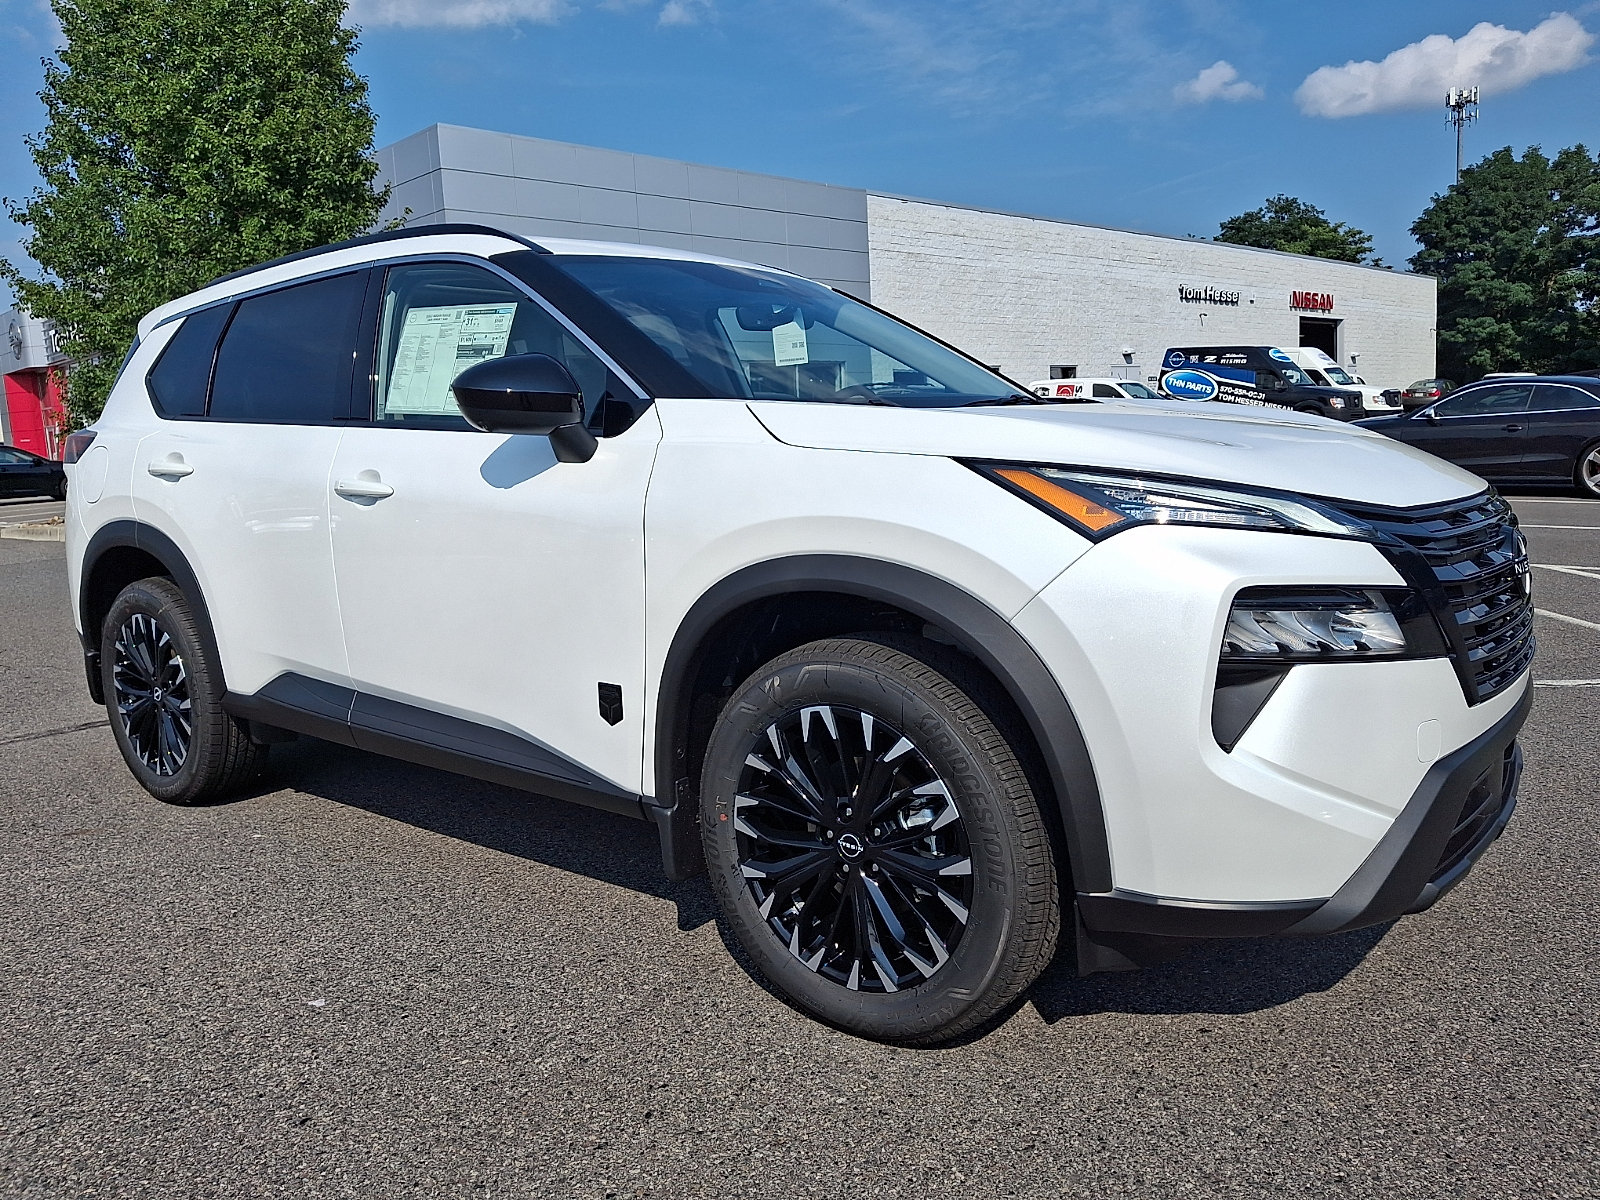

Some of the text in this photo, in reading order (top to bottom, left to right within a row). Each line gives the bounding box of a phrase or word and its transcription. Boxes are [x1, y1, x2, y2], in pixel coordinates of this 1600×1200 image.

[1181, 284, 1204, 300] Tom
[1292, 290, 1334, 309] NISSAN
[1168, 377, 1185, 389] THN
[1185, 381, 1213, 394] PARTS
[1218, 393, 1294, 412] TOM HESSER NISSAN
[919, 712, 1007, 896] BRIDGESTONE
[837, 839, 864, 852] NISSAN
